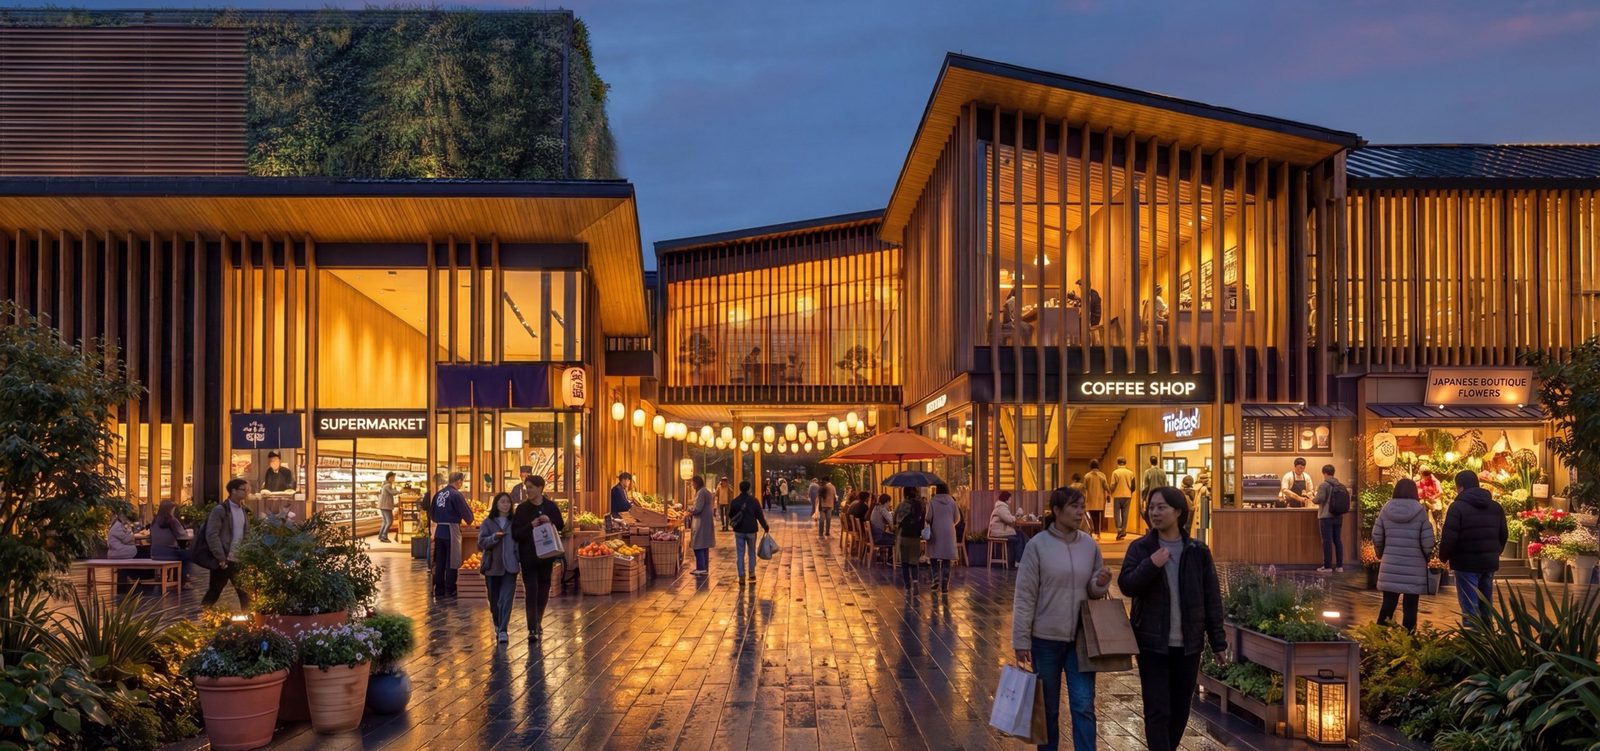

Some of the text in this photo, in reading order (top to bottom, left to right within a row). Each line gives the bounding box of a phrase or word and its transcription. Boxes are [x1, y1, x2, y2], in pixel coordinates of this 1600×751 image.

[1433, 378, 1527, 387] JAPANESE BOUTIQUE
[1081, 381, 1196, 395] COFFEE SHOP
[1458, 389, 1500, 398] FLOWERS
[320, 418, 425, 430] SUPERMARKET
